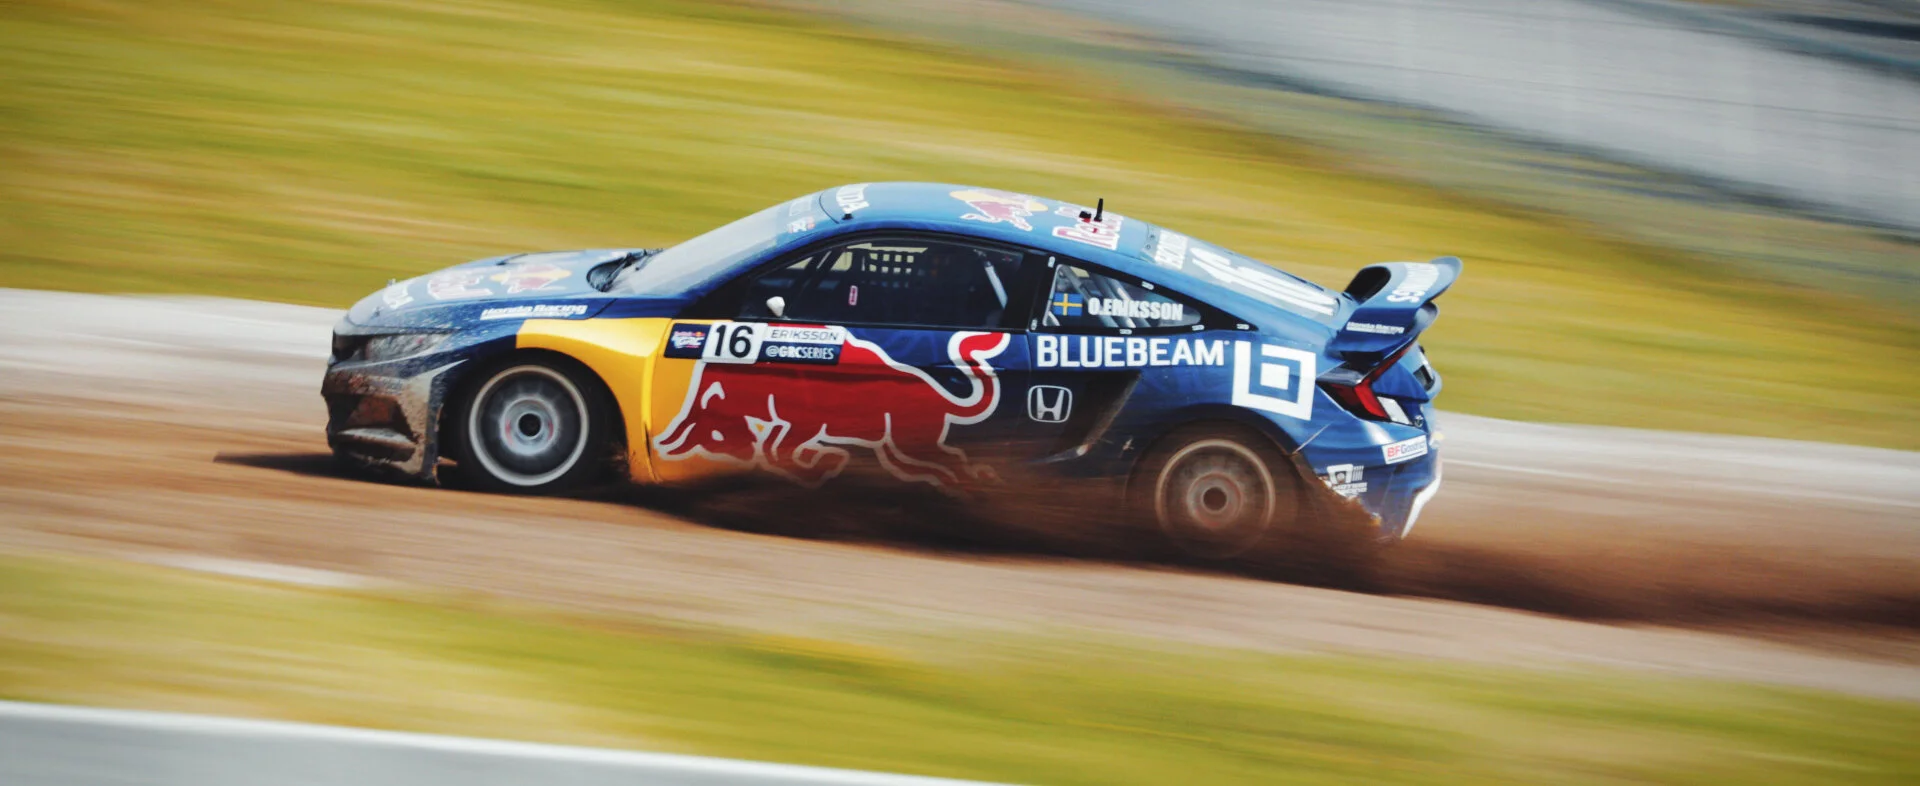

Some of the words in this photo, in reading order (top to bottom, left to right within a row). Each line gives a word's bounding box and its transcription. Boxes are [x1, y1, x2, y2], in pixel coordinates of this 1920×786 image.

[1087, 297, 1184, 321] O.ERIKSSON
[715, 324, 753, 358] 16
[770, 329, 840, 341] ERIKSSON
[765, 345, 835, 360] @GRCSERIES
[1036, 335, 1225, 368] BLUEBEAM
